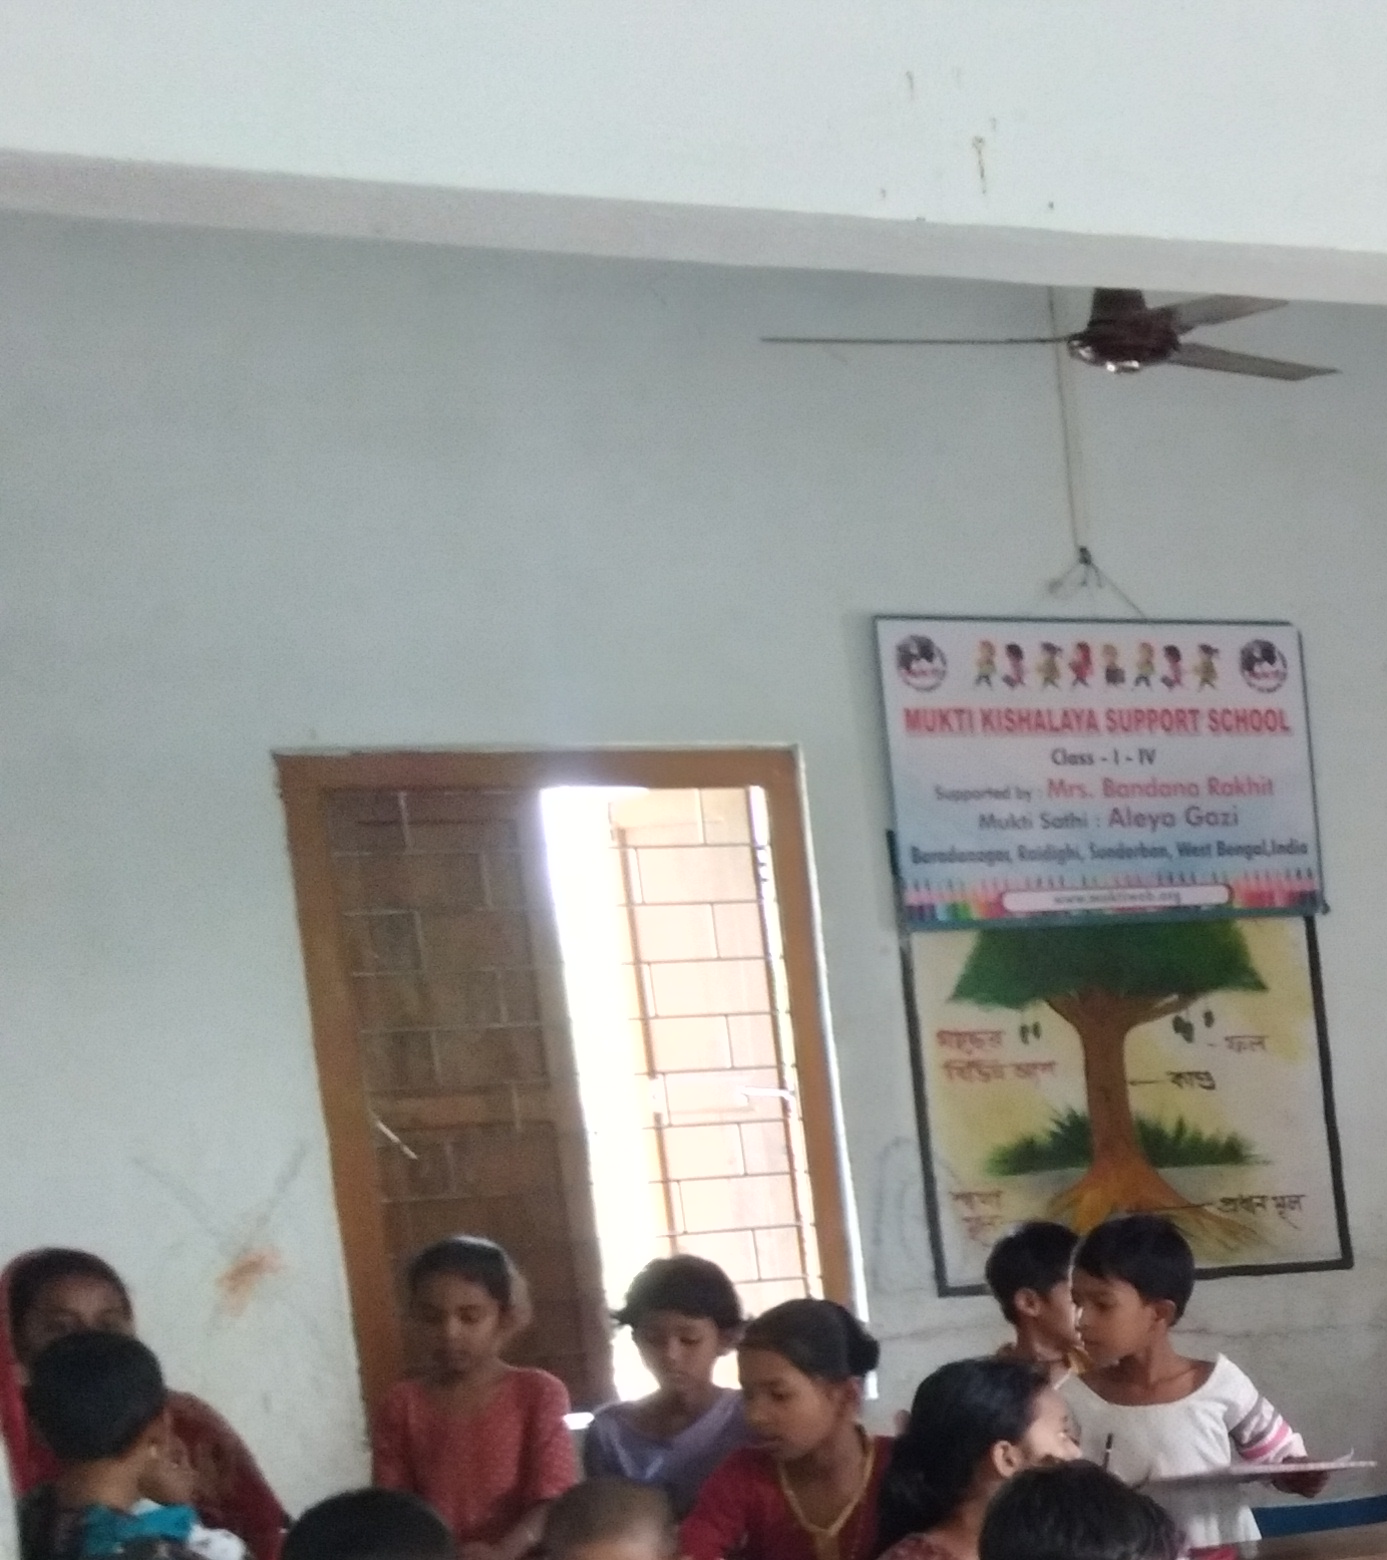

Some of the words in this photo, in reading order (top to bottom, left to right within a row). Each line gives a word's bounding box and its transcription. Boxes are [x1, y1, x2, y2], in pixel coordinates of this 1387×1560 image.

[904, 707, 974, 735] MUKTI
[982, 708, 1098, 732] KISHALAYA
[1105, 708, 1199, 732] SUPPORT
[1208, 708, 1291, 732] SCHOOL
[1051, 748, 1094, 766] Class
[1138, 749, 1157, 765] IV
[934, 784, 1010, 801] Supported
[1047, 778, 1094, 798] Mrs.
[1102, 778, 1199, 798] Bandana
[1207, 778, 1274, 797] Rakhit
[978, 813, 1032, 830] Mukti
[1040, 811, 1088, 830] Sathi
[1109, 806, 1176, 831] Aleya
[1185, 806, 1239, 828] Gazi
[1177, 842, 1212, 857] West
